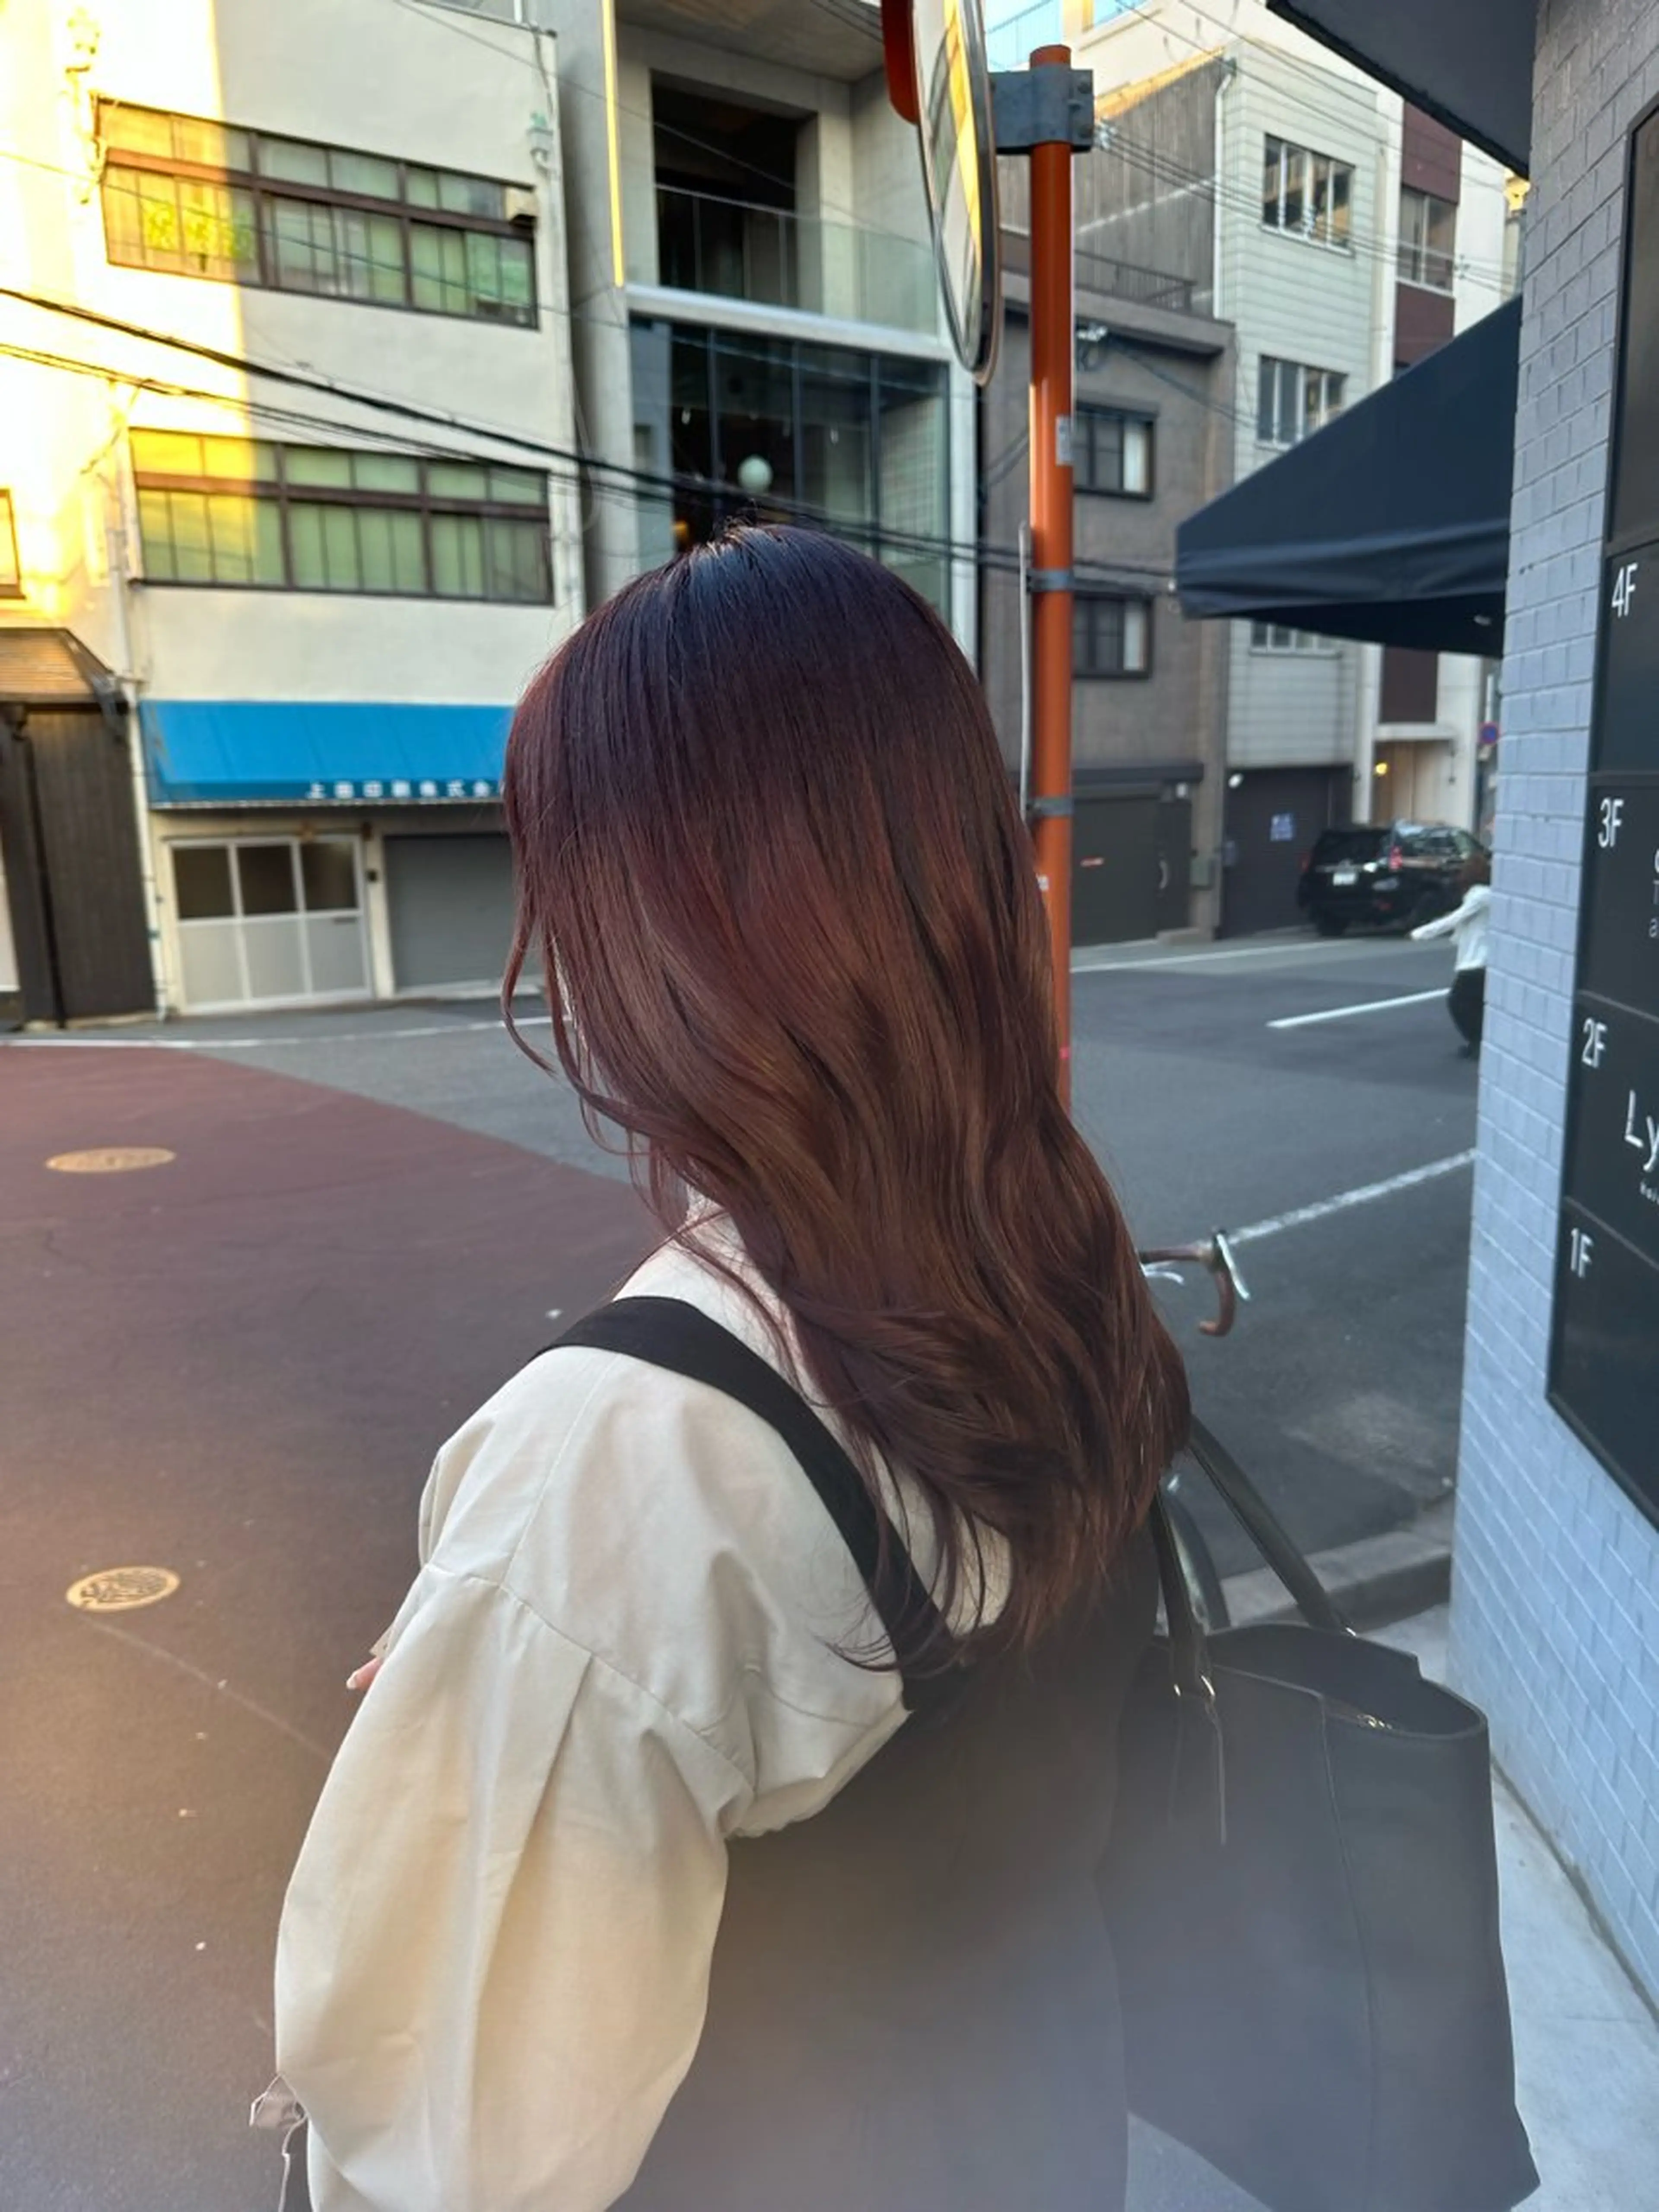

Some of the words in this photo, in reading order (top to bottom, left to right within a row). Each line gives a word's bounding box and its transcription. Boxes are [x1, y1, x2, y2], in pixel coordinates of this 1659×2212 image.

[1611, 562, 1639, 618] 4F
[1598, 797, 1624, 848] 3F
[1582, 1017, 1608, 1068] 2F
[1570, 1227, 1595, 1279] 1F
